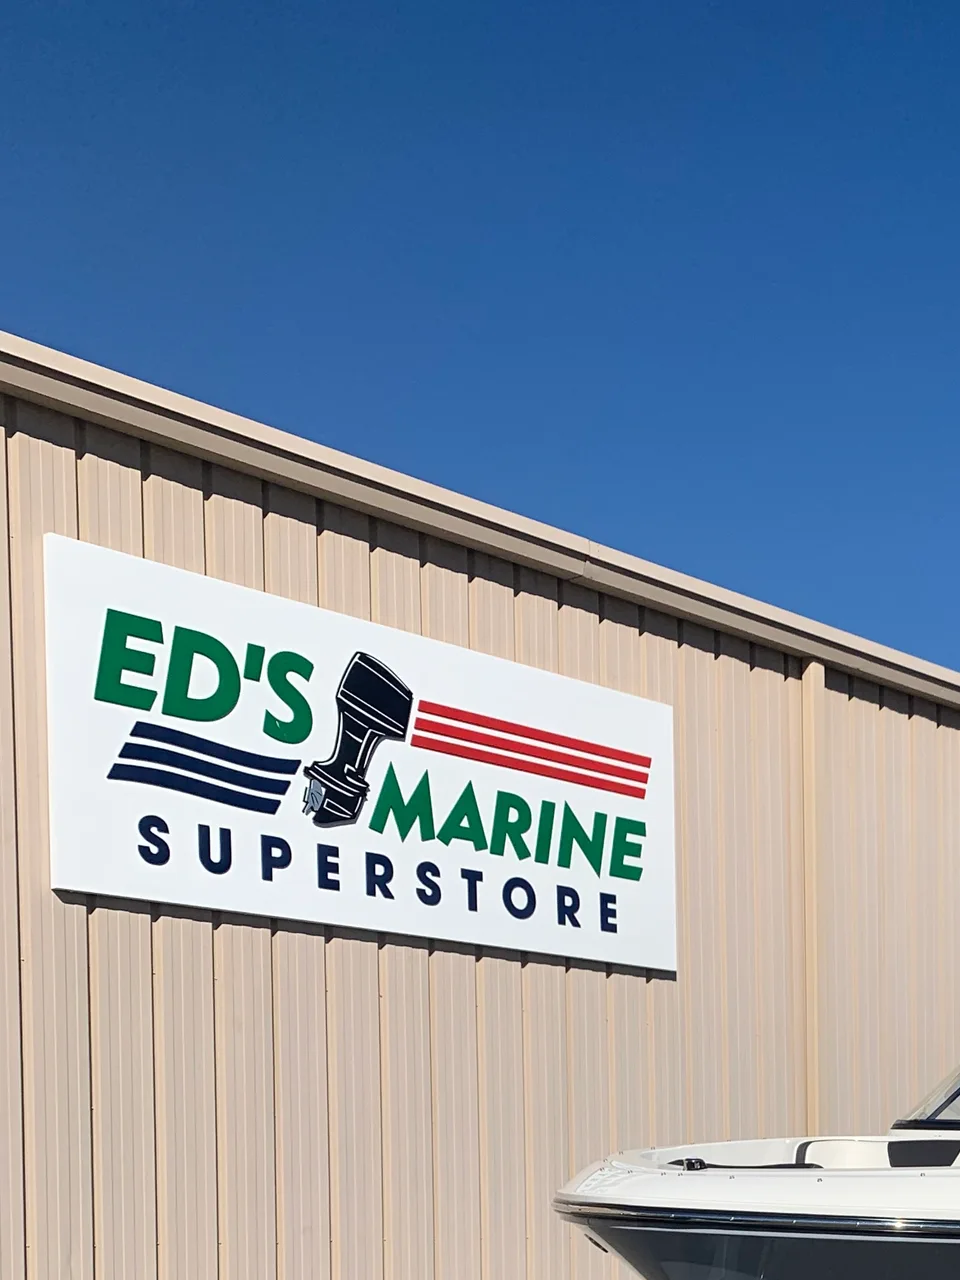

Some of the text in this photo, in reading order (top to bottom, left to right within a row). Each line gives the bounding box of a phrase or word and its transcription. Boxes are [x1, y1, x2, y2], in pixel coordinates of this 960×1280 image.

[94, 608, 314, 744] ED'S
[137, 814, 619, 934] SUPERSTORE
[368, 761, 647, 882] MARINE
